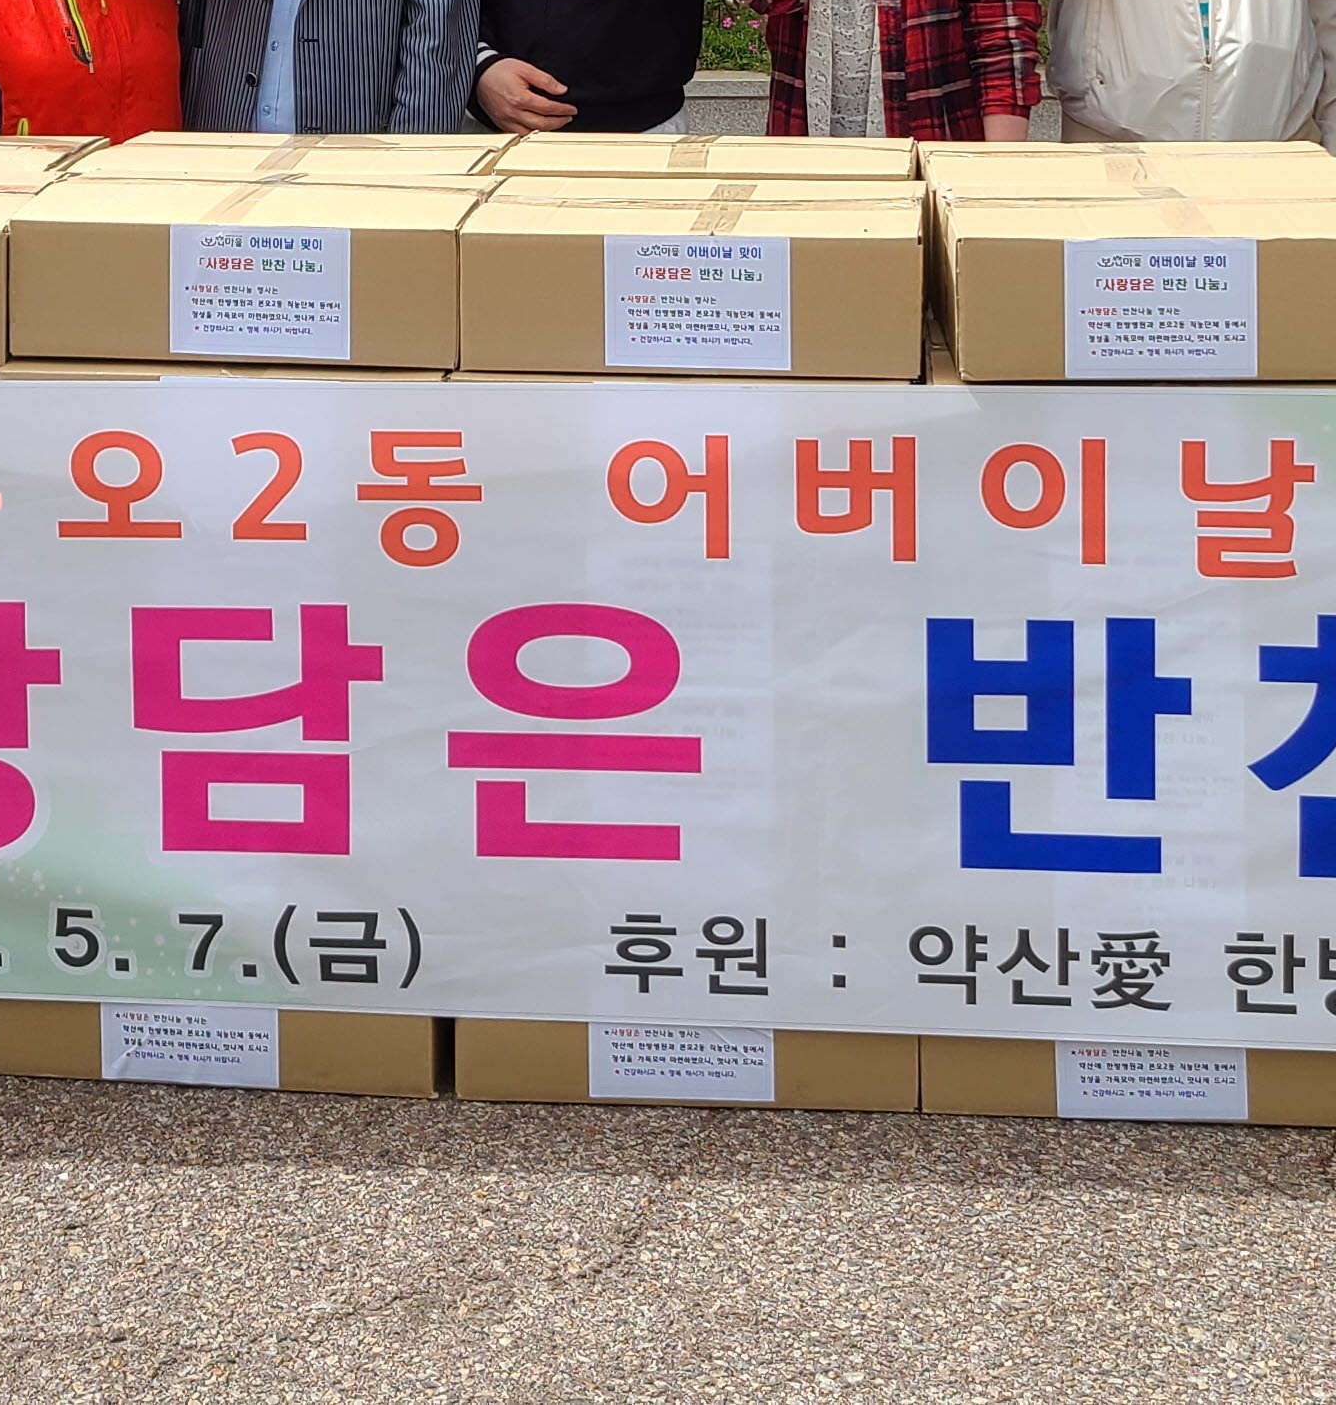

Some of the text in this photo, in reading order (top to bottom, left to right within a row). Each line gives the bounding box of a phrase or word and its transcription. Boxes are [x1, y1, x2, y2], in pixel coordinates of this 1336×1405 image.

[250, 237, 294, 250] 어버이날
[301, 239, 323, 250] 맞이
[687, 246, 732, 259] 어버이날
[739, 247, 762, 259] 맞이
[262, 259, 285, 271] 반찬
[293, 260, 323, 272] 나눔」
[1149, 255, 1196, 269] 어버이날
[1204, 255, 1227, 268] 맞이
[699, 269, 723, 281] 반찬
[731, 269, 762, 281] 나눔」
[1162, 278, 1187, 291] 반찬
[1195, 278, 1227, 291] 나눔」
[606, 435, 1317, 579] 어버이날
[54, 908, 129, 974] 5.
[178, 903, 422, 988] 7.(금)
[604, 913, 770, 997] 후원
[908, 925, 1172, 1012] 약산愛
